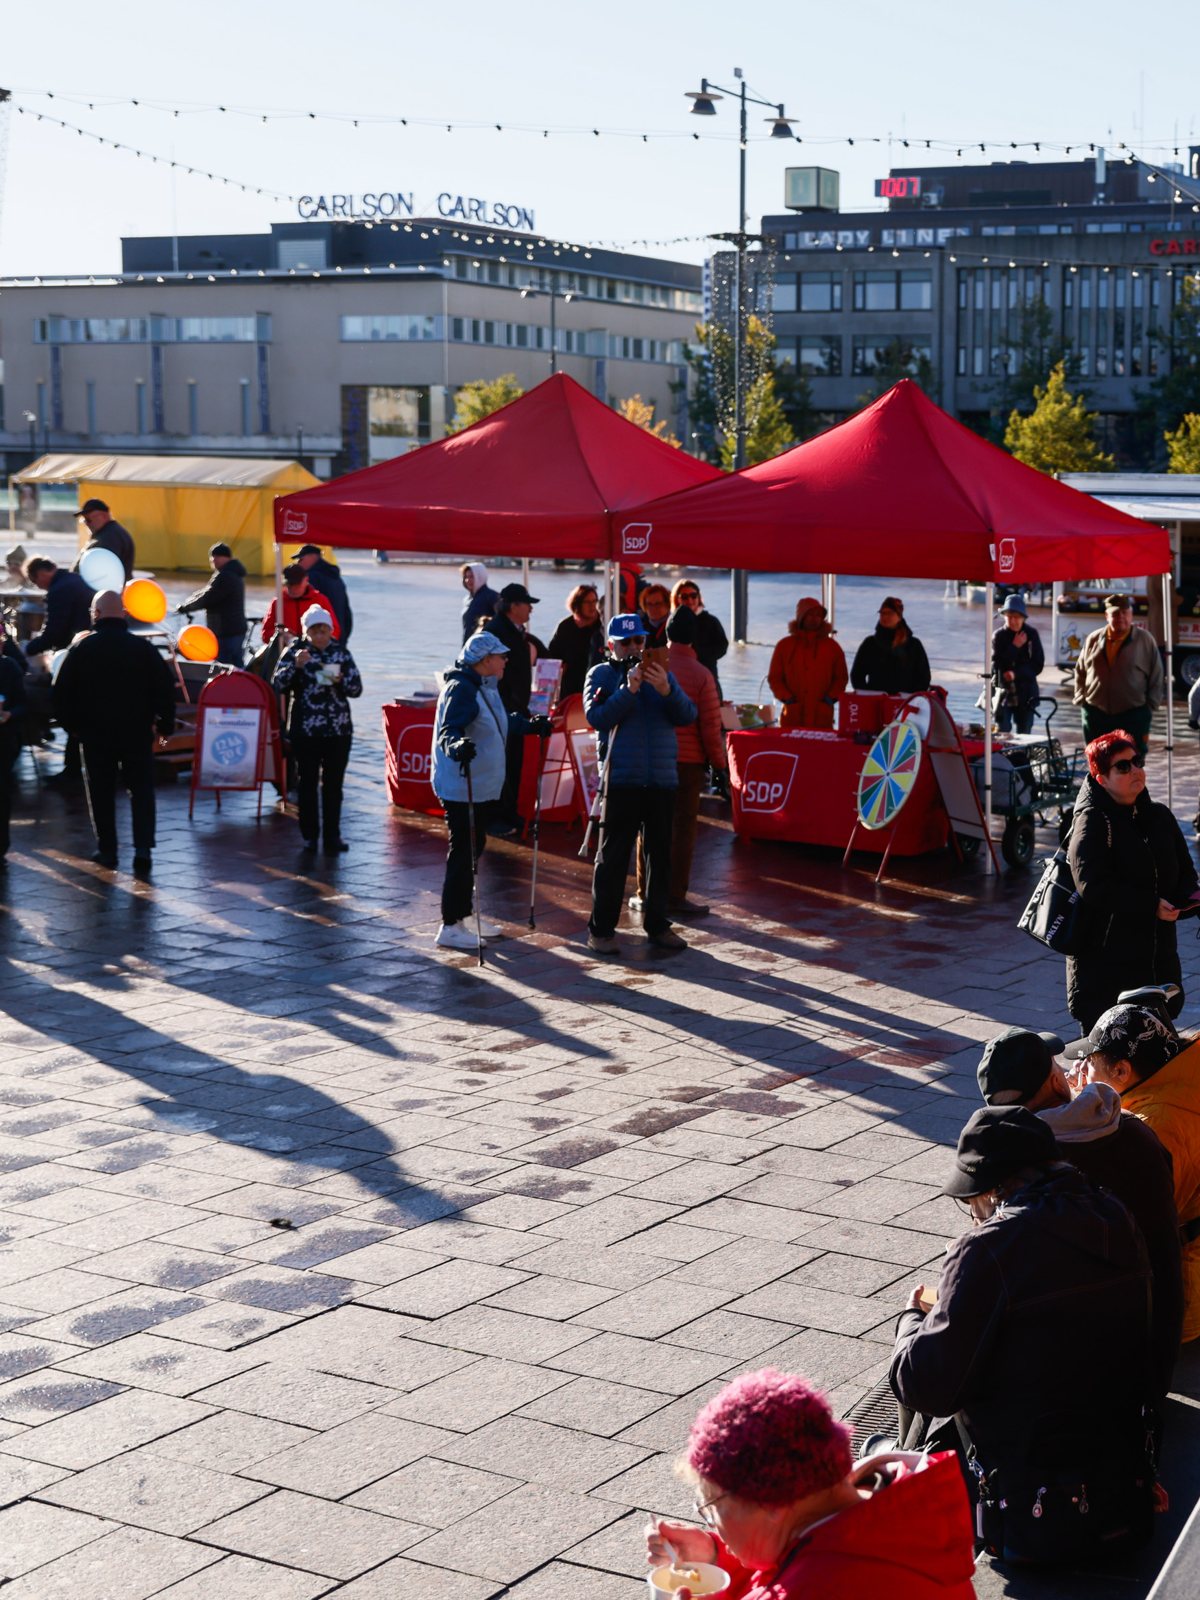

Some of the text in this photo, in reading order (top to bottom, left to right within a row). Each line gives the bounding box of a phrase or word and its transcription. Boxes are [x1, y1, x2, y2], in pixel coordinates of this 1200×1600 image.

[297, 193, 535, 231] CARLSON CARLSON
[804, 230, 870, 247] LADY
[626, 537, 646, 549] SDP
[1001, 555, 1013, 567] SDP
[745, 780, 784, 804] SDP
[1045, 913, 1065, 941] OKLYN
